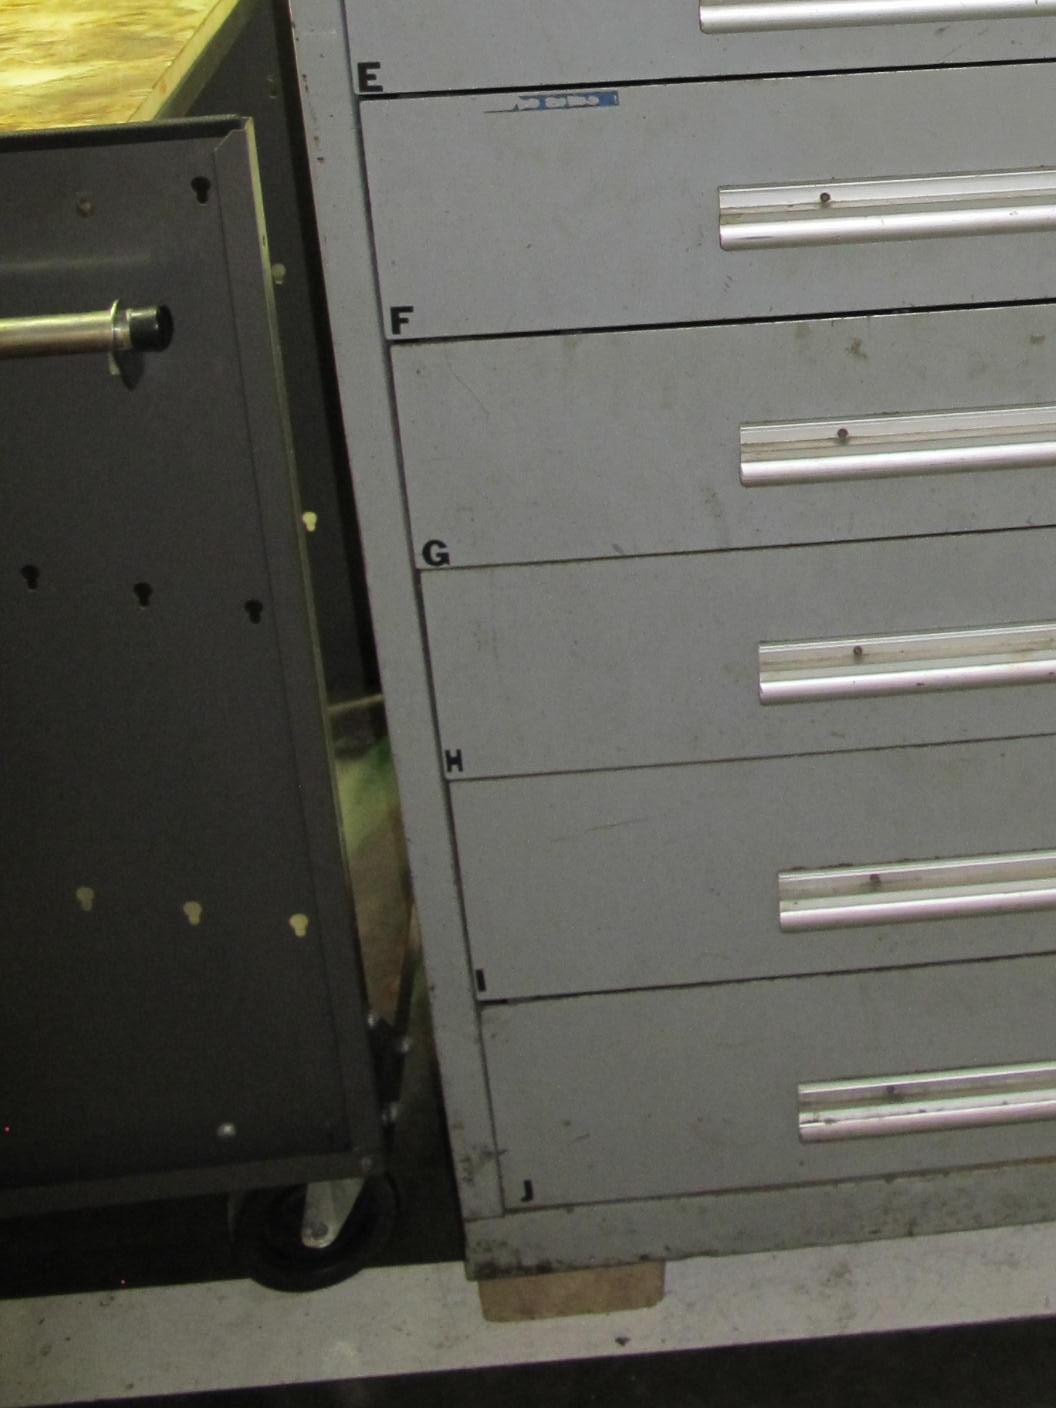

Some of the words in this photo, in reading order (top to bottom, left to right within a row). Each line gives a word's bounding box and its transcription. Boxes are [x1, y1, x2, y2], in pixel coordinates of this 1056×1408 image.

[357, 62, 384, 93] E
[390, 305, 415, 336] F
[422, 539, 450, 567] G
[444, 749, 464, 773] H
[521, 1179, 535, 1203] J
